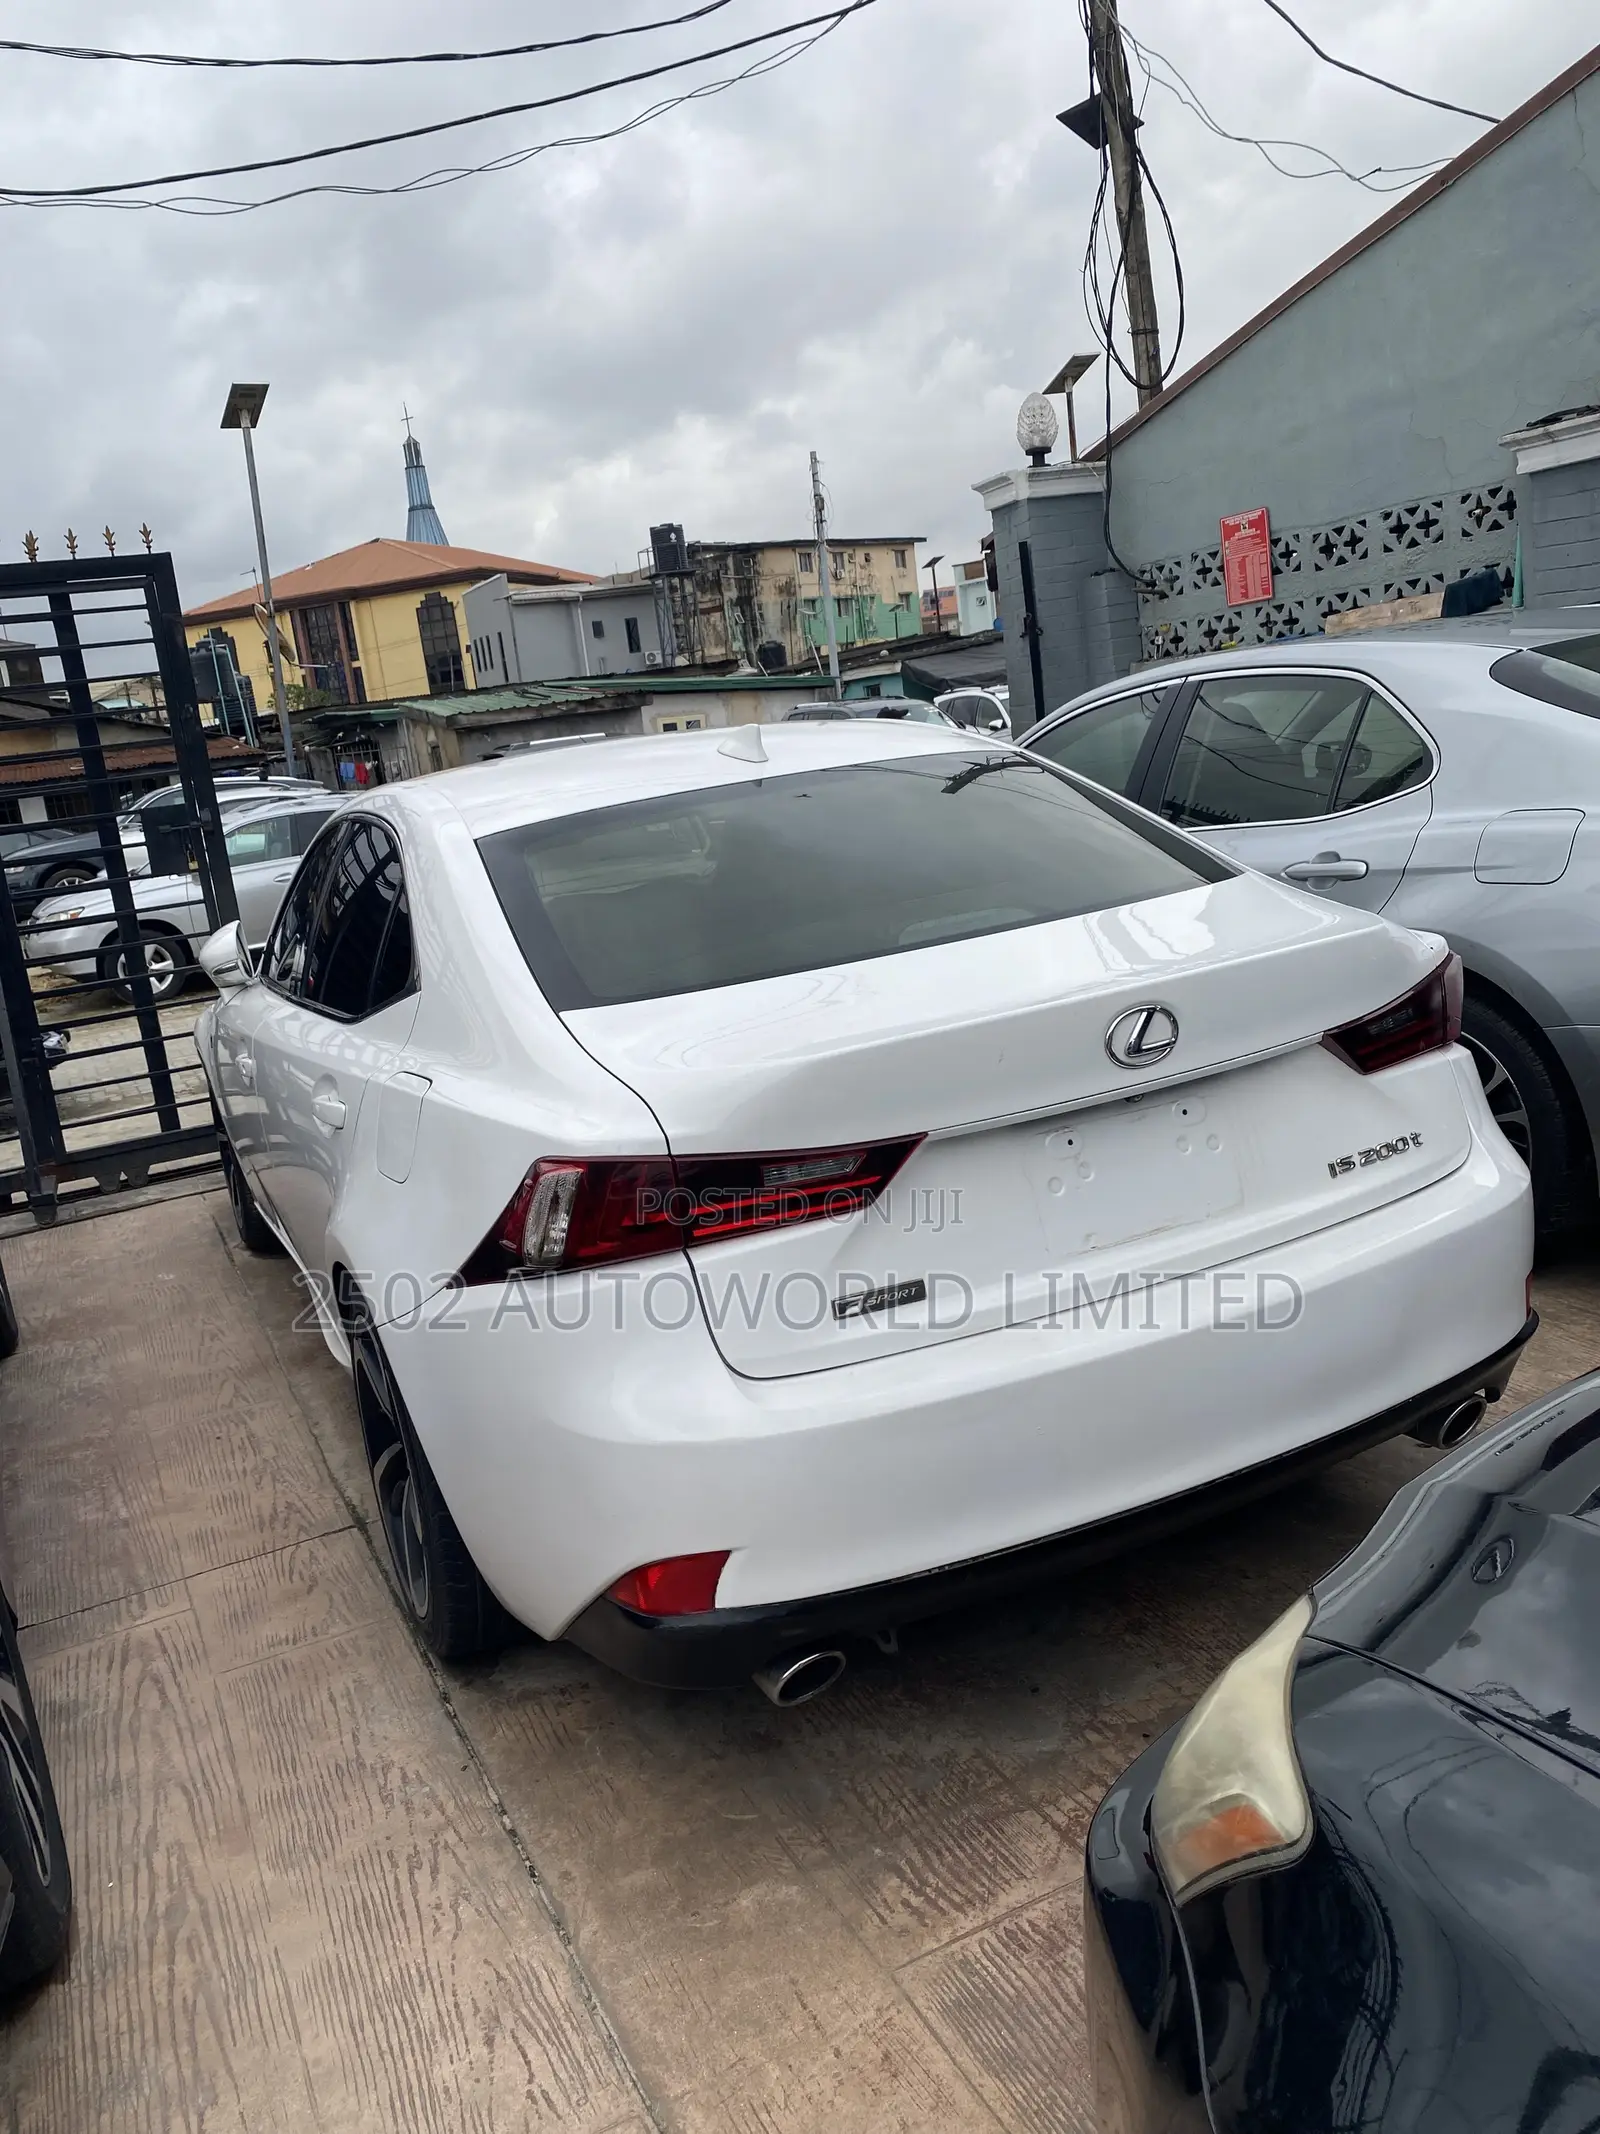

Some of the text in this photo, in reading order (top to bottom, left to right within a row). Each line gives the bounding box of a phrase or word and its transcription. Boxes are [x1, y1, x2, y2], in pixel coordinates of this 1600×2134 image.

[1327, 1131, 1424, 1179] IS 200t
[865, 1285, 919, 1307] SPORT
